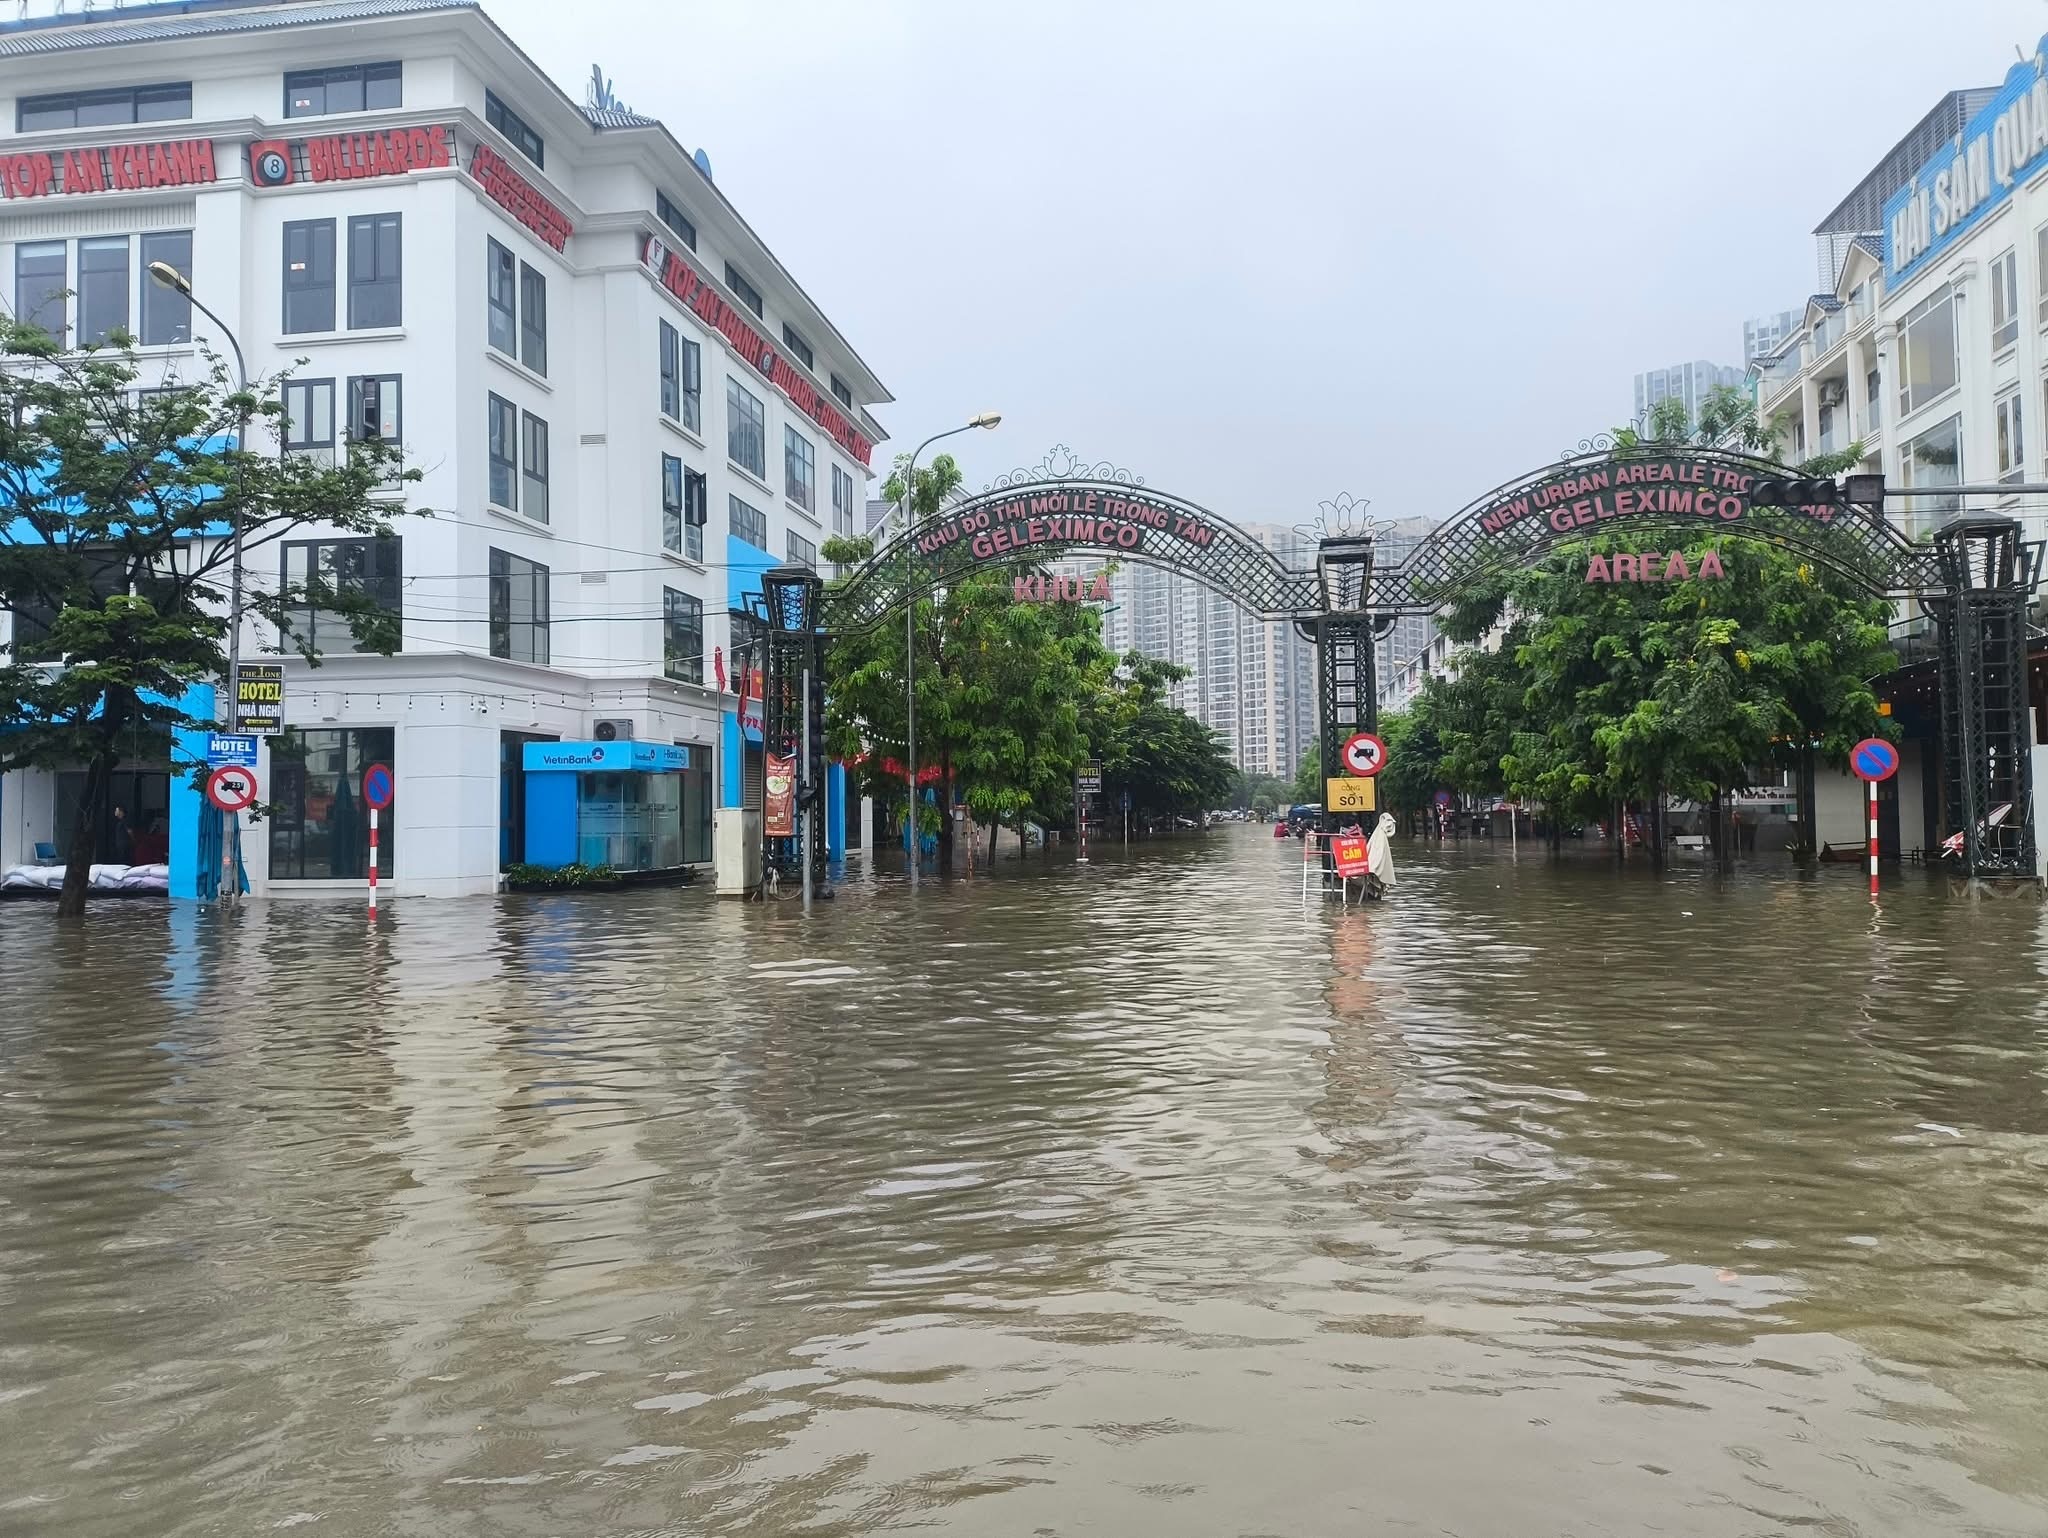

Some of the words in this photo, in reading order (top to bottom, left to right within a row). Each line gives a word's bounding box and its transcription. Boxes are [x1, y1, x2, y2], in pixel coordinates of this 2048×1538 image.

[0, 153, 52, 199] TOP
[63, 147, 105, 194] AN
[108, 139, 217, 190] KHANH
[306, 125, 449, 182] BILLIARDS
[1891, 175, 1930, 274] HẢI
[1934, 132, 1990, 237] SẢN
[665, 252, 698, 303] TOP
[693, 284, 721, 326] AN
[716, 301, 761, 366] KHANH
[1482, 497, 1529, 533] NEW
[1532, 471, 1610, 508] URBAN
[1615, 464, 1675, 485] AREA
[1679, 465, 1707, 483] LE
[1550, 489, 1743, 532] GELEXIMCO
[919, 524, 959, 554] KHU
[962, 508, 990, 534] ĐÔ
[993, 501, 1026, 522] THỊ
[1073, 494, 1098, 512] LÊ
[1103, 498, 1169, 528] TRỌNG
[972, 519, 1139, 558] GELEXIMCO
[1584, 551, 1691, 583] AREA
[1698, 550, 1726, 579] A
[1014, 576, 1084, 601] KHU
[1088, 575, 1114, 601] A
[238, 682, 282, 700] HOTEL
[264, 671, 281, 679] ONE
[237, 702, 257, 717] NHÀ
[211, 740, 253, 752] HOTEL
[543, 755, 593, 765] VietinBank
[1079, 767, 1099, 777] HOTEL
